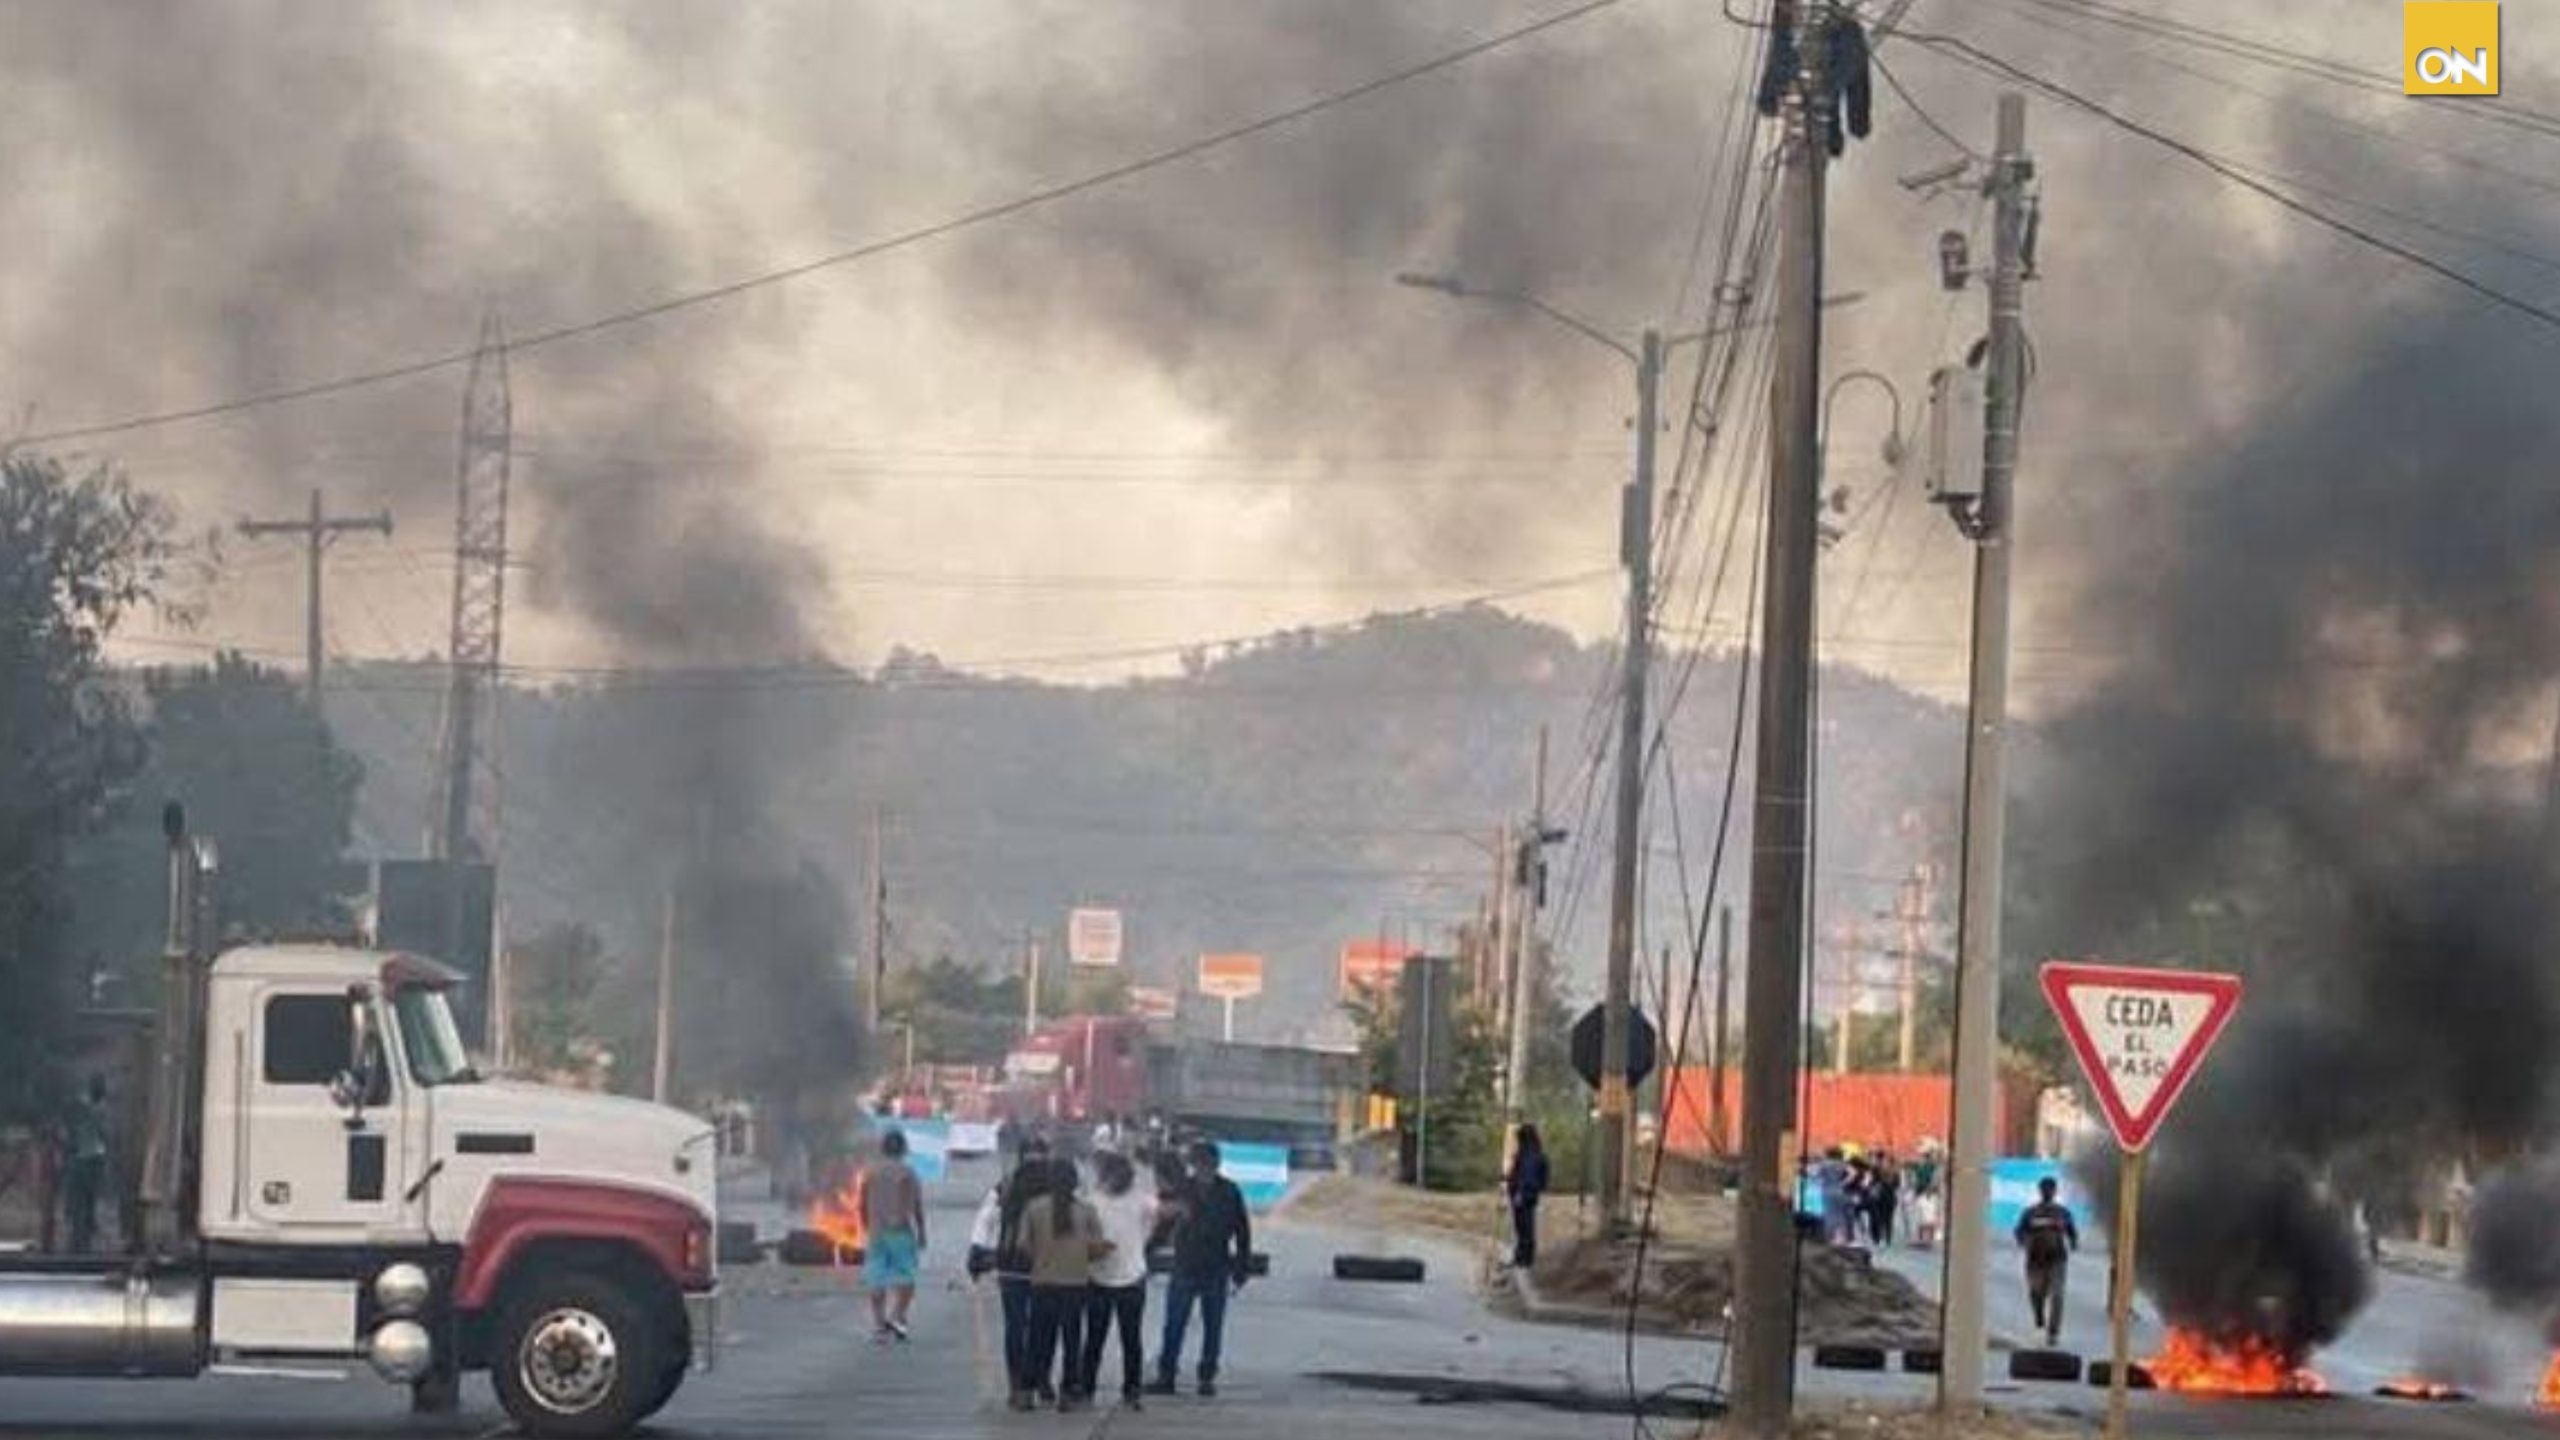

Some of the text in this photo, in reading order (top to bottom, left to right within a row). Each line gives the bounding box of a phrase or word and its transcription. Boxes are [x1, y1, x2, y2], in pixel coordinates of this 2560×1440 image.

[2106, 995, 2173, 1027] CEDA
[2124, 1033, 2148, 1052] EL
[2106, 1055, 2167, 1076] PASO
